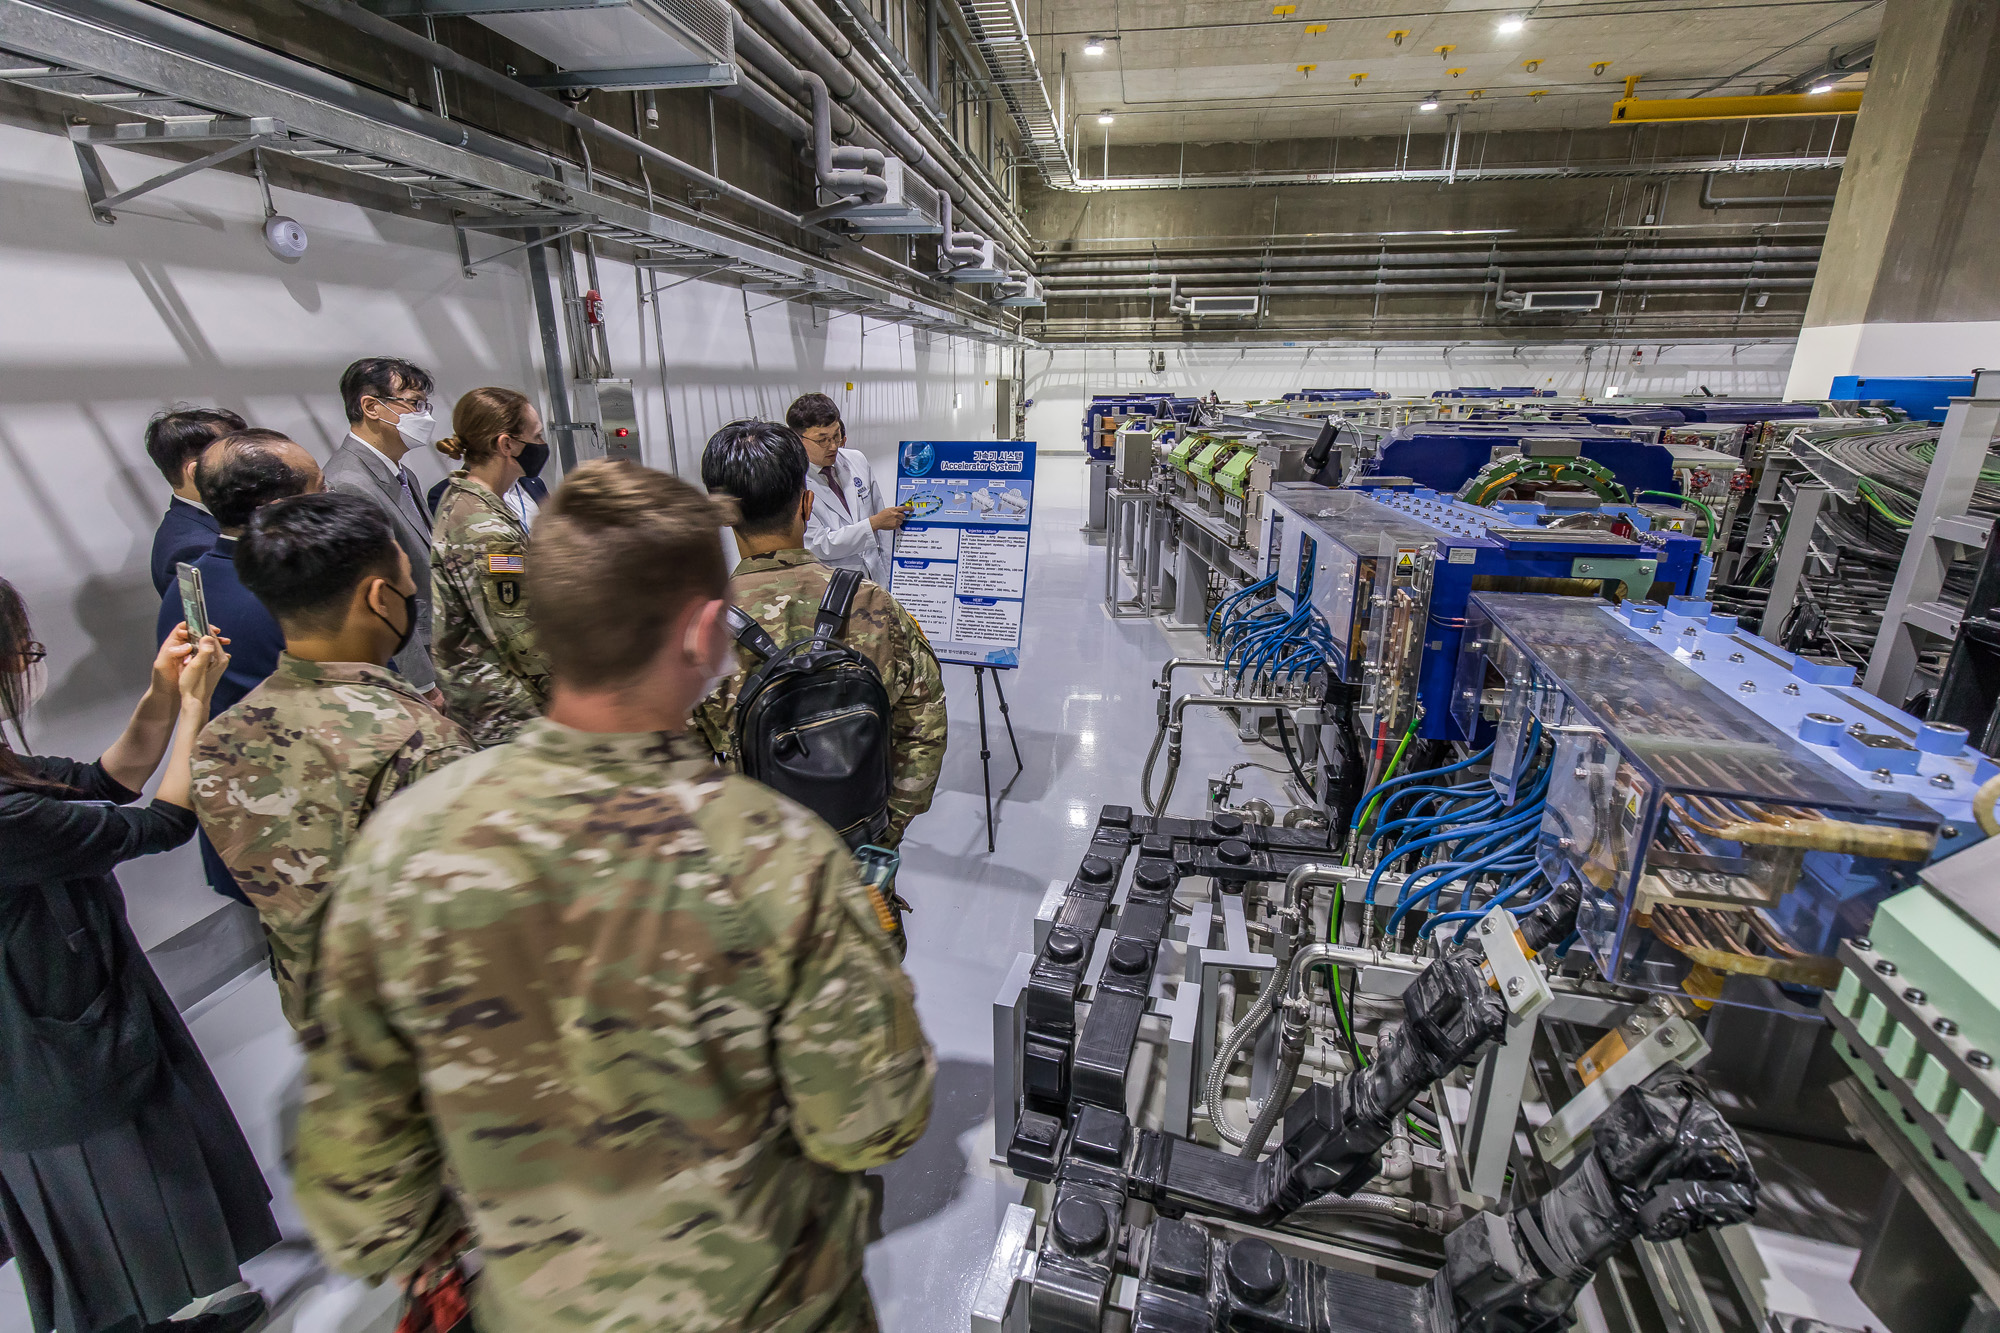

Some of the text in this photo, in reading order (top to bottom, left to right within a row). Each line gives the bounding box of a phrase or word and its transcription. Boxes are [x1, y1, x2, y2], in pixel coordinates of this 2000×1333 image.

[974, 451, 1023, 462] 가속기 시스템
[941, 461, 1023, 472] (Accelerator System)
